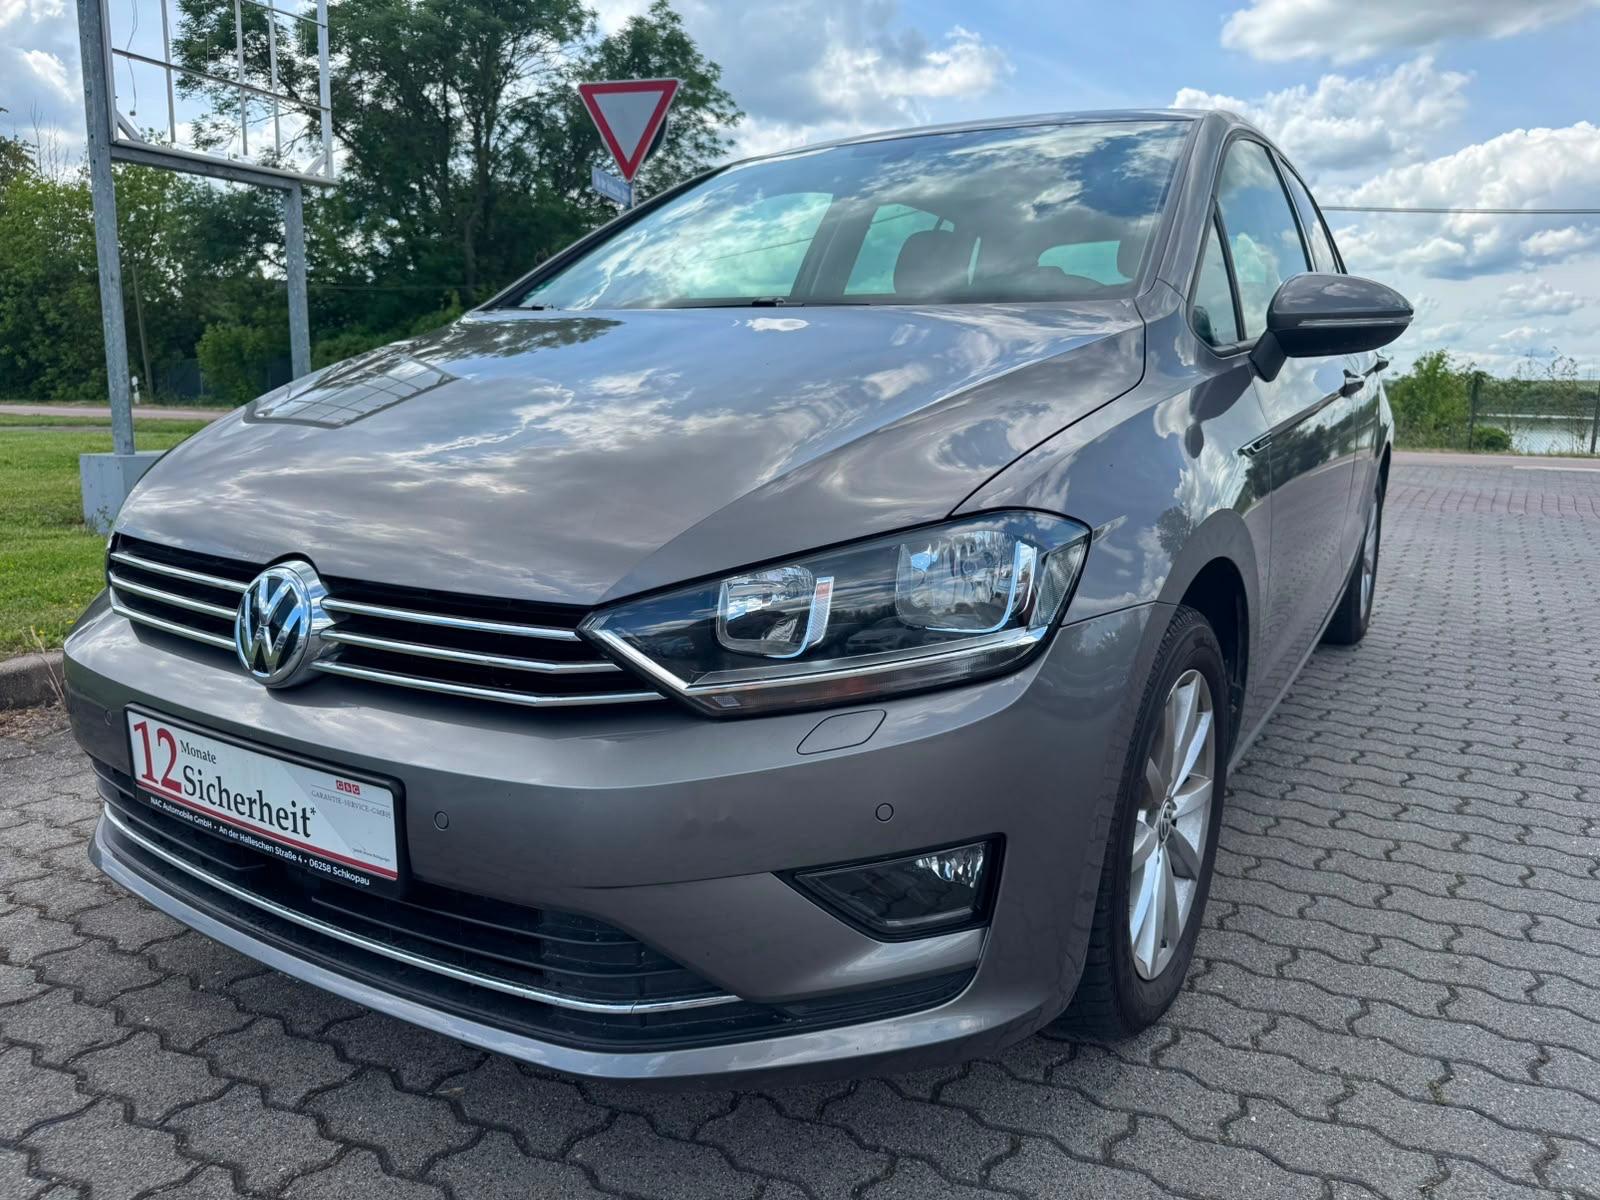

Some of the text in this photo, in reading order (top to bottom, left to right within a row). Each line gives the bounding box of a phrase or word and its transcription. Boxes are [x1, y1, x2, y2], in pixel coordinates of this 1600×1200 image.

[133, 721, 182, 794] 12
[180, 740, 217, 765] Monate
[162, 802, 194, 821] Automobile
[193, 815, 212, 828] GmbH
[219, 826, 228, 835] An
[228, 829, 239, 839] der
[240, 834, 274, 853] Halleschen
[275, 846, 297, 861] Straße
[298, 855, 303, 863] 4
[309, 858, 332, 873] 06258
[332, 866, 370, 886] Schkopau
